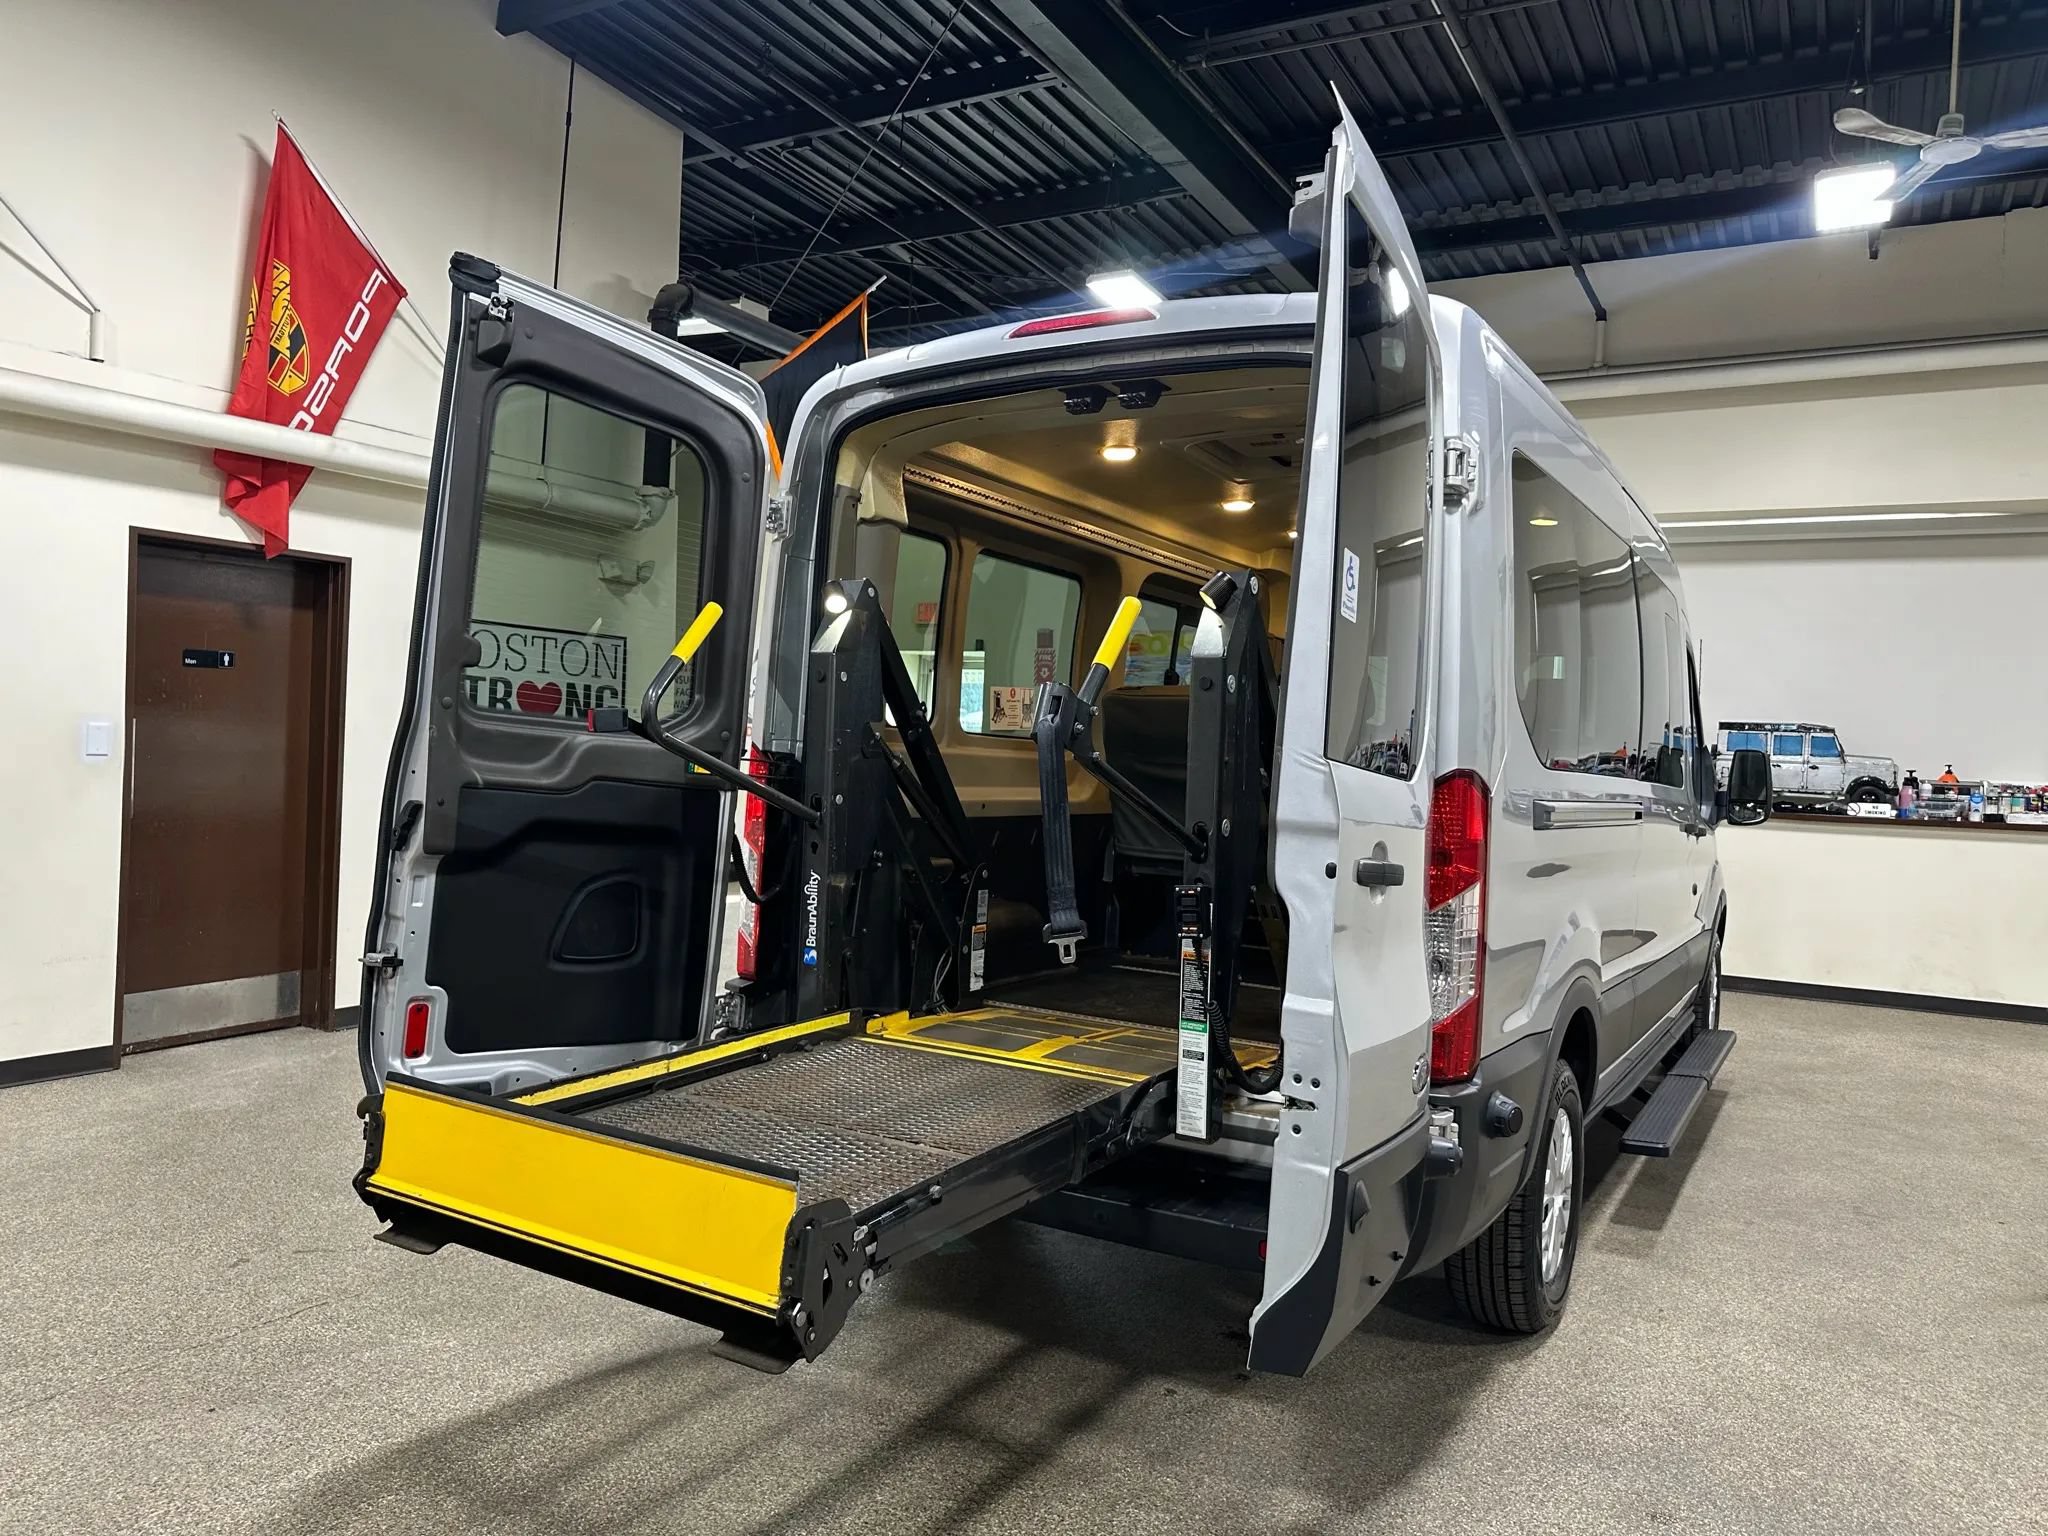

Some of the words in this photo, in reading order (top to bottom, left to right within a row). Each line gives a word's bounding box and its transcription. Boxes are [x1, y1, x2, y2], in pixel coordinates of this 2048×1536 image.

[185, 657, 196, 665] Men
[471, 629, 622, 680] OSTON
[804, 869, 821, 947] BraunAbility
